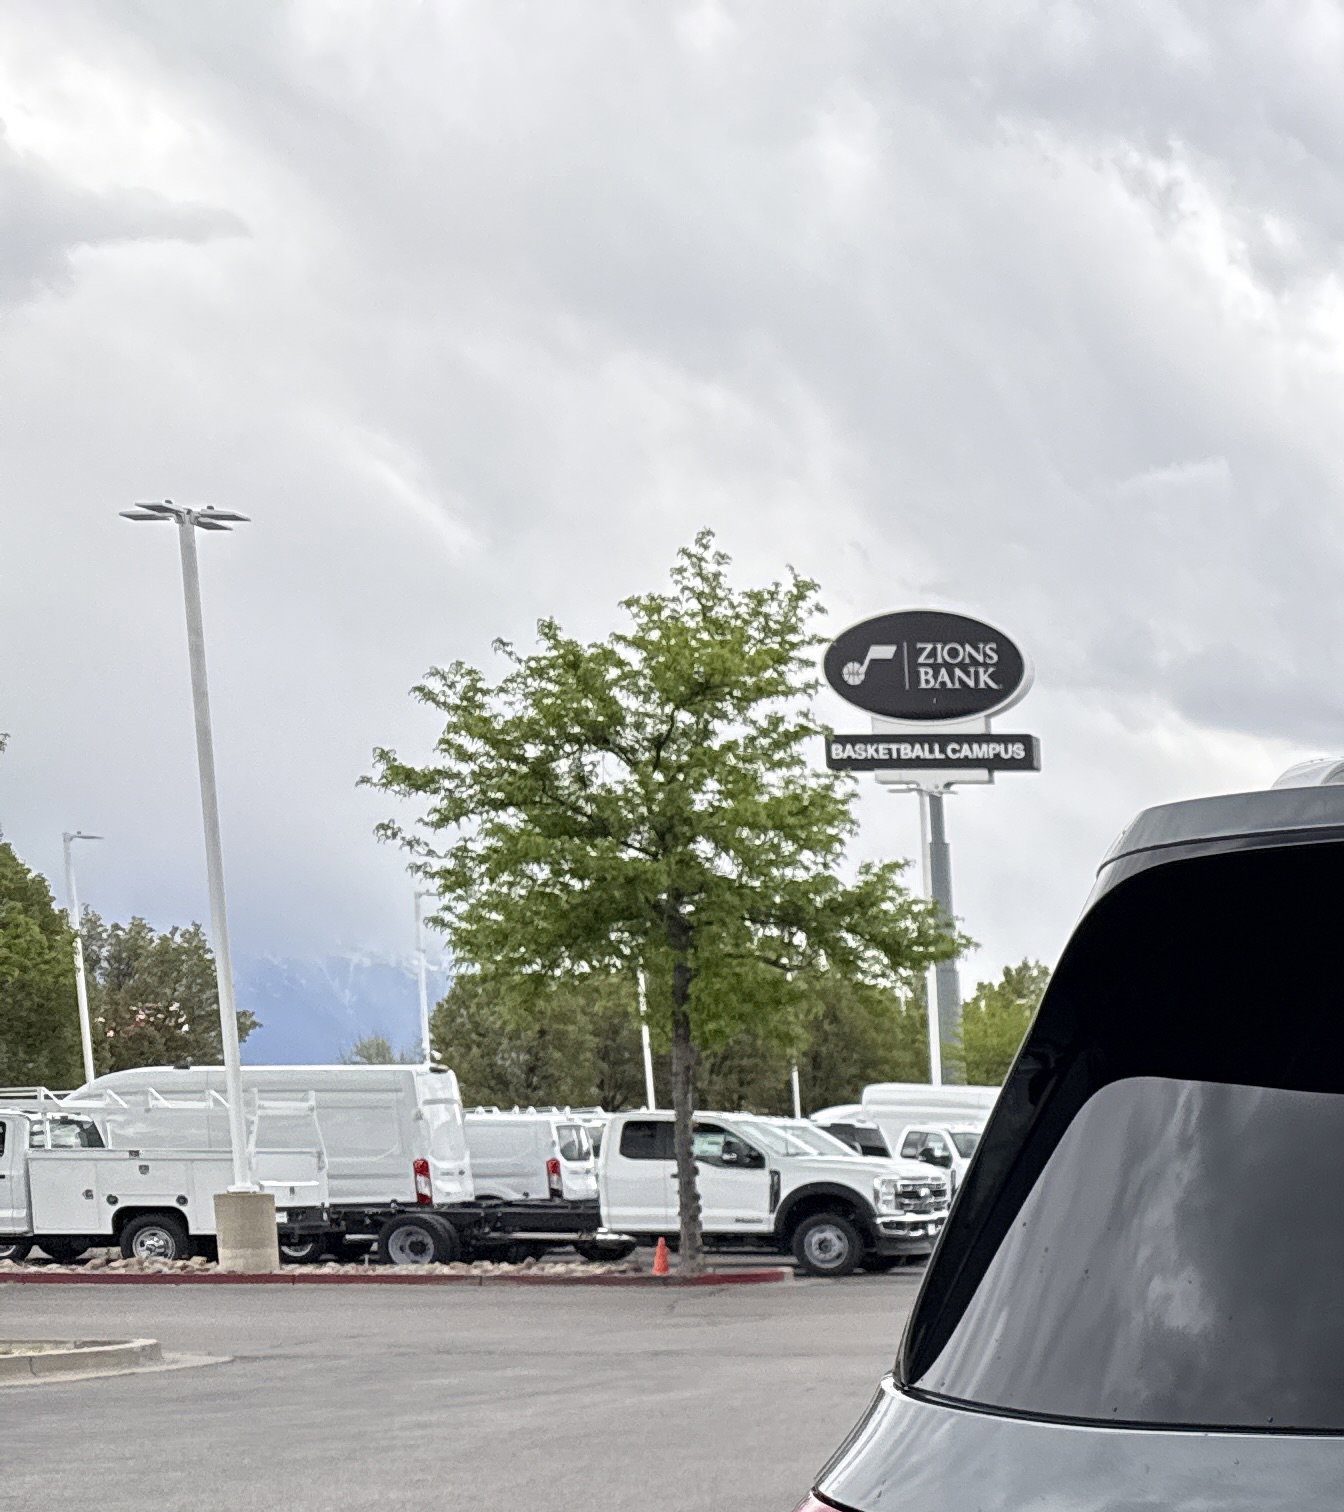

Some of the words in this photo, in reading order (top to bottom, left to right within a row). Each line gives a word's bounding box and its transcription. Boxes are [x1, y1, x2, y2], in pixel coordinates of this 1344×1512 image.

[916, 641, 998, 665] ZIONS
[917, 666, 1001, 690] BANK
[831, 743, 945, 760] BASKETBALL
[947, 742, 1025, 759] CAMPUS
